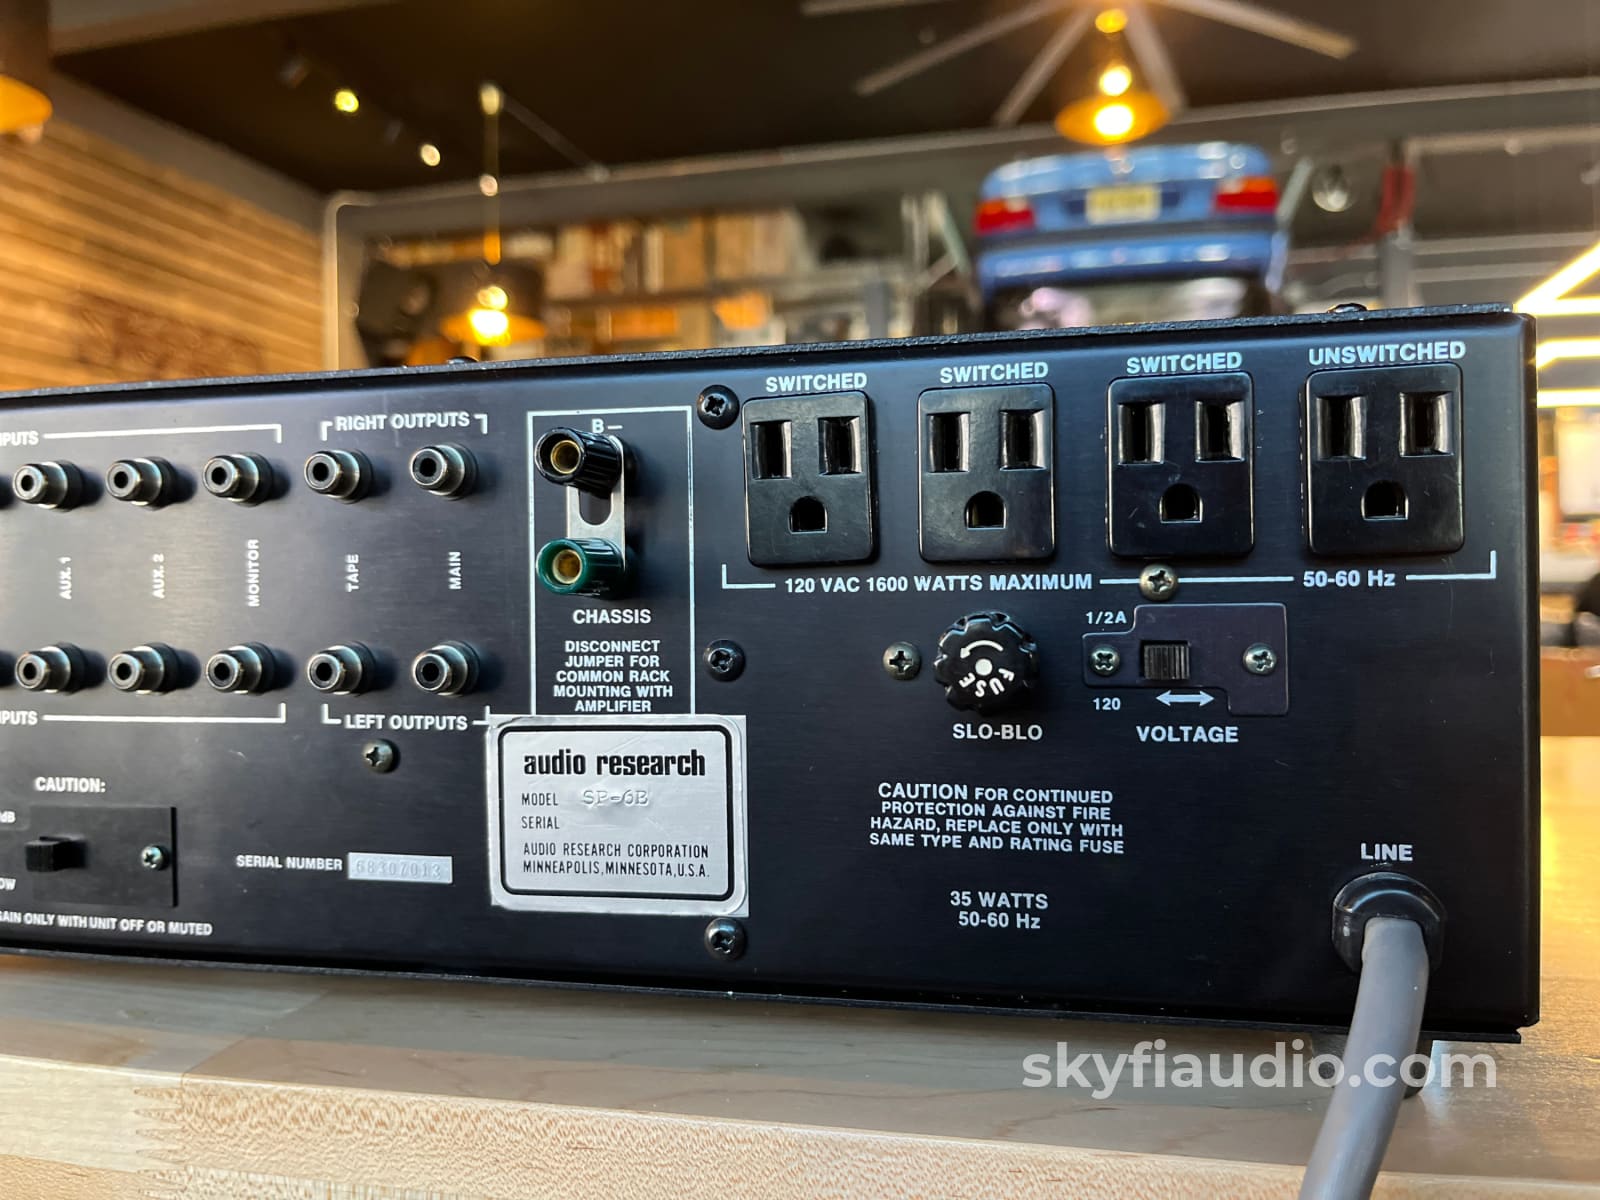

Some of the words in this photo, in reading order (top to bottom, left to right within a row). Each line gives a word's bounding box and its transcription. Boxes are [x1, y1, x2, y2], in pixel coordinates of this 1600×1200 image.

[1309, 341, 1466, 367] UNSWITCHED
[940, 362, 1048, 383] SWITCHED
[1127, 352, 1242, 375] SWITCHED
[766, 372, 867, 392] SWITCHED
[334, 414, 387, 431] RIGHT
[390, 411, 470, 429] OUTPUTS
[152, 554, 164, 562] 2
[247, 539, 260, 607] MONITOR
[346, 554, 359, 592] TAPE
[448, 552, 461, 589] MAIN
[1303, 570, 1360, 587] 50-60
[1368, 569, 1395, 587] Hz
[59, 567, 72, 599] AUX.
[152, 565, 165, 599] AUX.
[785, 578, 815, 593] 120
[820, 577, 860, 592] VAC
[866, 576, 908, 592] 1600
[914, 575, 983, 591] WATTS
[990, 573, 1092, 591] MAXIMUM
[573, 609, 651, 624] CHASSIS
[1086, 611, 1127, 624] 1/2A
[565, 640, 660, 653] DISCONNECT
[565, 655, 624, 668] JUMPER
[630, 655, 660, 667] FOR
[556, 670, 623, 683] COMMON
[629, 670, 670, 682] RACK
[959, 668, 1015, 697] FUSE
[553, 685, 631, 697] MOUNTING
[635, 685, 673, 698] WITH
[574, 700, 651, 712] AMPLIFIER
[1093, 697, 1121, 710] 120
[345, 714, 385, 729] LEFT
[389, 715, 468, 730] OUTPUTS
[953, 723, 1042, 740] SLO-BLO
[1136, 726, 1239, 743] VOLTAGE
[524, 749, 586, 775] audio
[597, 749, 705, 776] research
[35, 777, 106, 793] CAUTION:
[878, 782, 967, 800] CAUTION
[975, 787, 1008, 801] FOR
[1013, 788, 1113, 803] CONTINUED
[521, 793, 558, 806] MODEL
[583, 789, 649, 807] SP-6B
[0, 811, 16, 823] dB
[882, 801, 985, 816] PROTECTION
[992, 804, 1066, 819] AGAINST
[1073, 806, 1111, 820] FIRE
[521, 816, 560, 829] SERIAL
[871, 817, 940, 833] HAZARD,
[946, 818, 1021, 834] REPLACE
[1027, 821, 1073, 835] ONLY
[1080, 823, 1123, 837] WITH
[523, 842, 556, 856] AUDIO
[563, 842, 621, 857] RESEARCH
[628, 844, 708, 858] CORPORATION
[870, 833, 914, 846] SAME
[920, 834, 962, 848] TYPE
[968, 836, 1003, 849] AND
[1010, 837, 1072, 852] RATING
[1080, 839, 1124, 854] FUSE
[1361, 843, 1413, 861] LINE
[236, 855, 283, 868] SERIAL
[285, 856, 342, 870] NUMBER
[950, 891, 972, 906] 35
[978, 891, 1048, 909] WATTS
[23, 912, 55, 925] ONLY
[57, 915, 88, 928] WITH
[88, 916, 118, 930] UNIT
[119, 919, 144, 931] OFF
[146, 920, 165, 933] OR
[168, 921, 212, 936] MUTED
[959, 911, 1009, 928] 50-60
[1016, 913, 1040, 929] Hz
